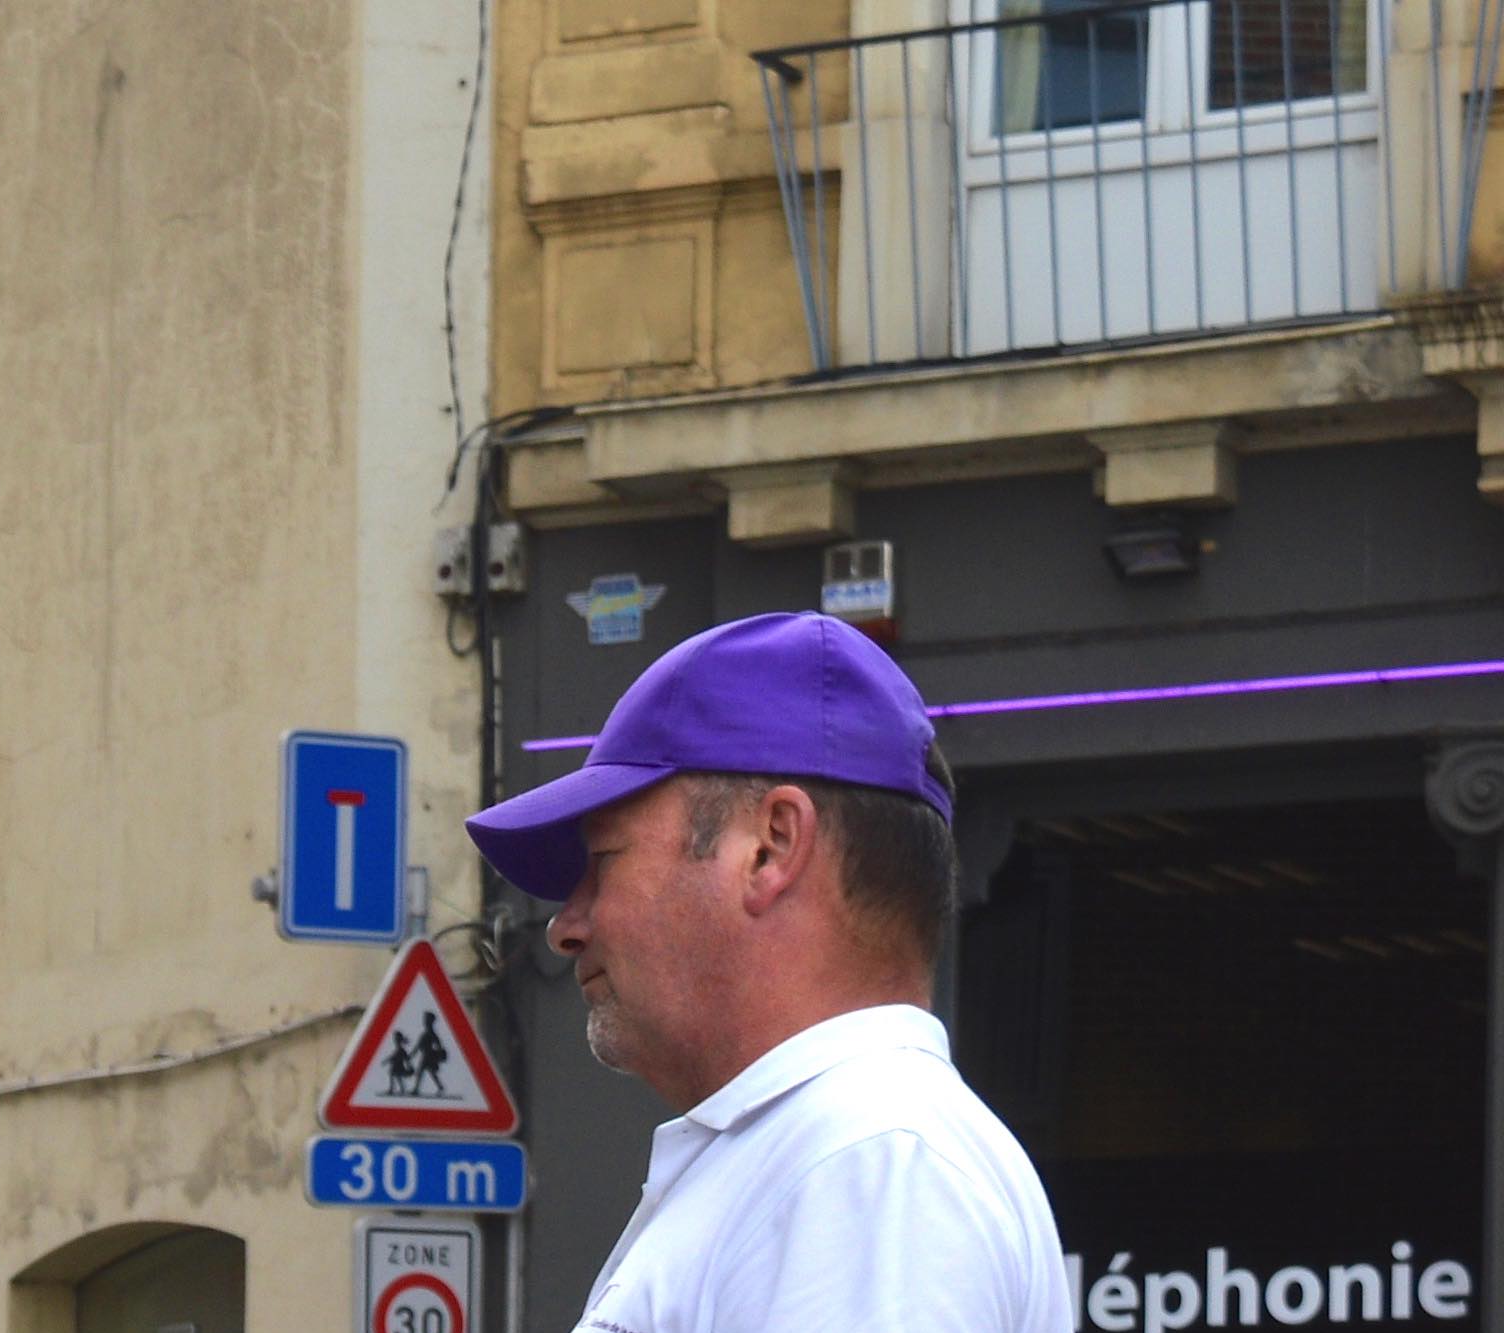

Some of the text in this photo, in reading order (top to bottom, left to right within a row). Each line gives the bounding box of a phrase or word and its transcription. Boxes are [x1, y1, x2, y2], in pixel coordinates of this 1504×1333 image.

[339, 1144, 496, 1202] 30 m
[388, 1245, 450, 1267] ZONE
